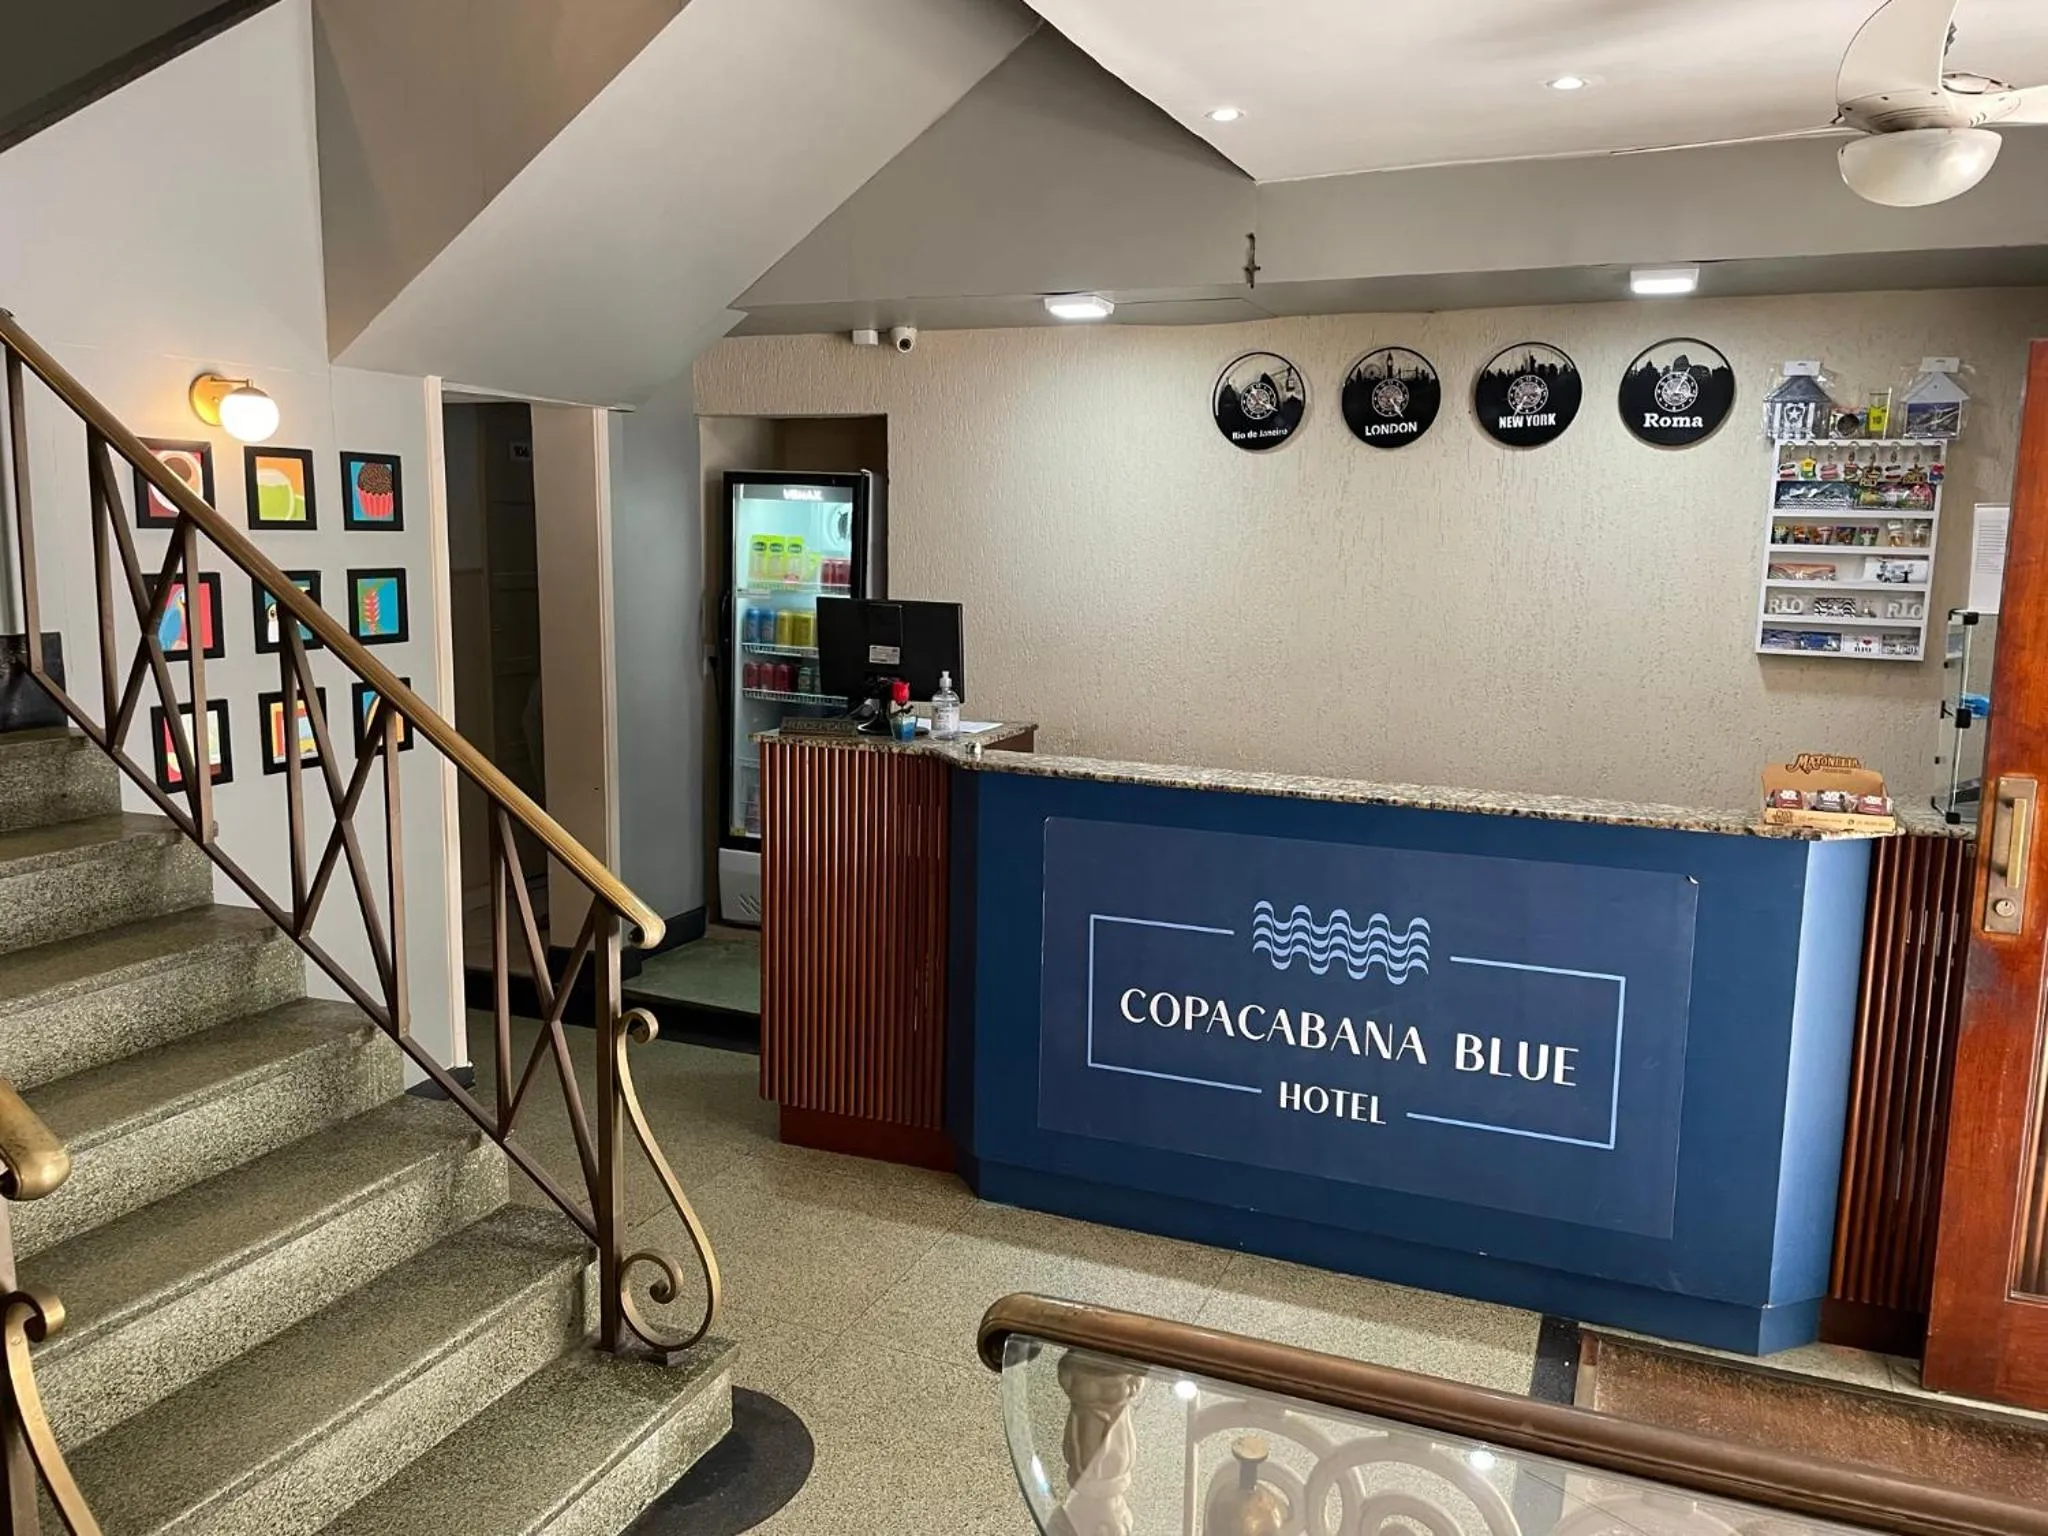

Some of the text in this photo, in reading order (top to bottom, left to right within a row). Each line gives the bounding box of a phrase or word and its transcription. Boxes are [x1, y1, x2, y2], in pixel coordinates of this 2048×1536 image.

[1498, 413, 1557, 429] NEW YORK
[1642, 413, 1704, 428] Roma
[1232, 427, 1288, 440] Rio de Janeiro
[1364, 421, 1418, 436] LONDON
[1120, 988, 1580, 1087] COPACABANA BLUE
[1279, 1081, 1387, 1125] HOTEL
